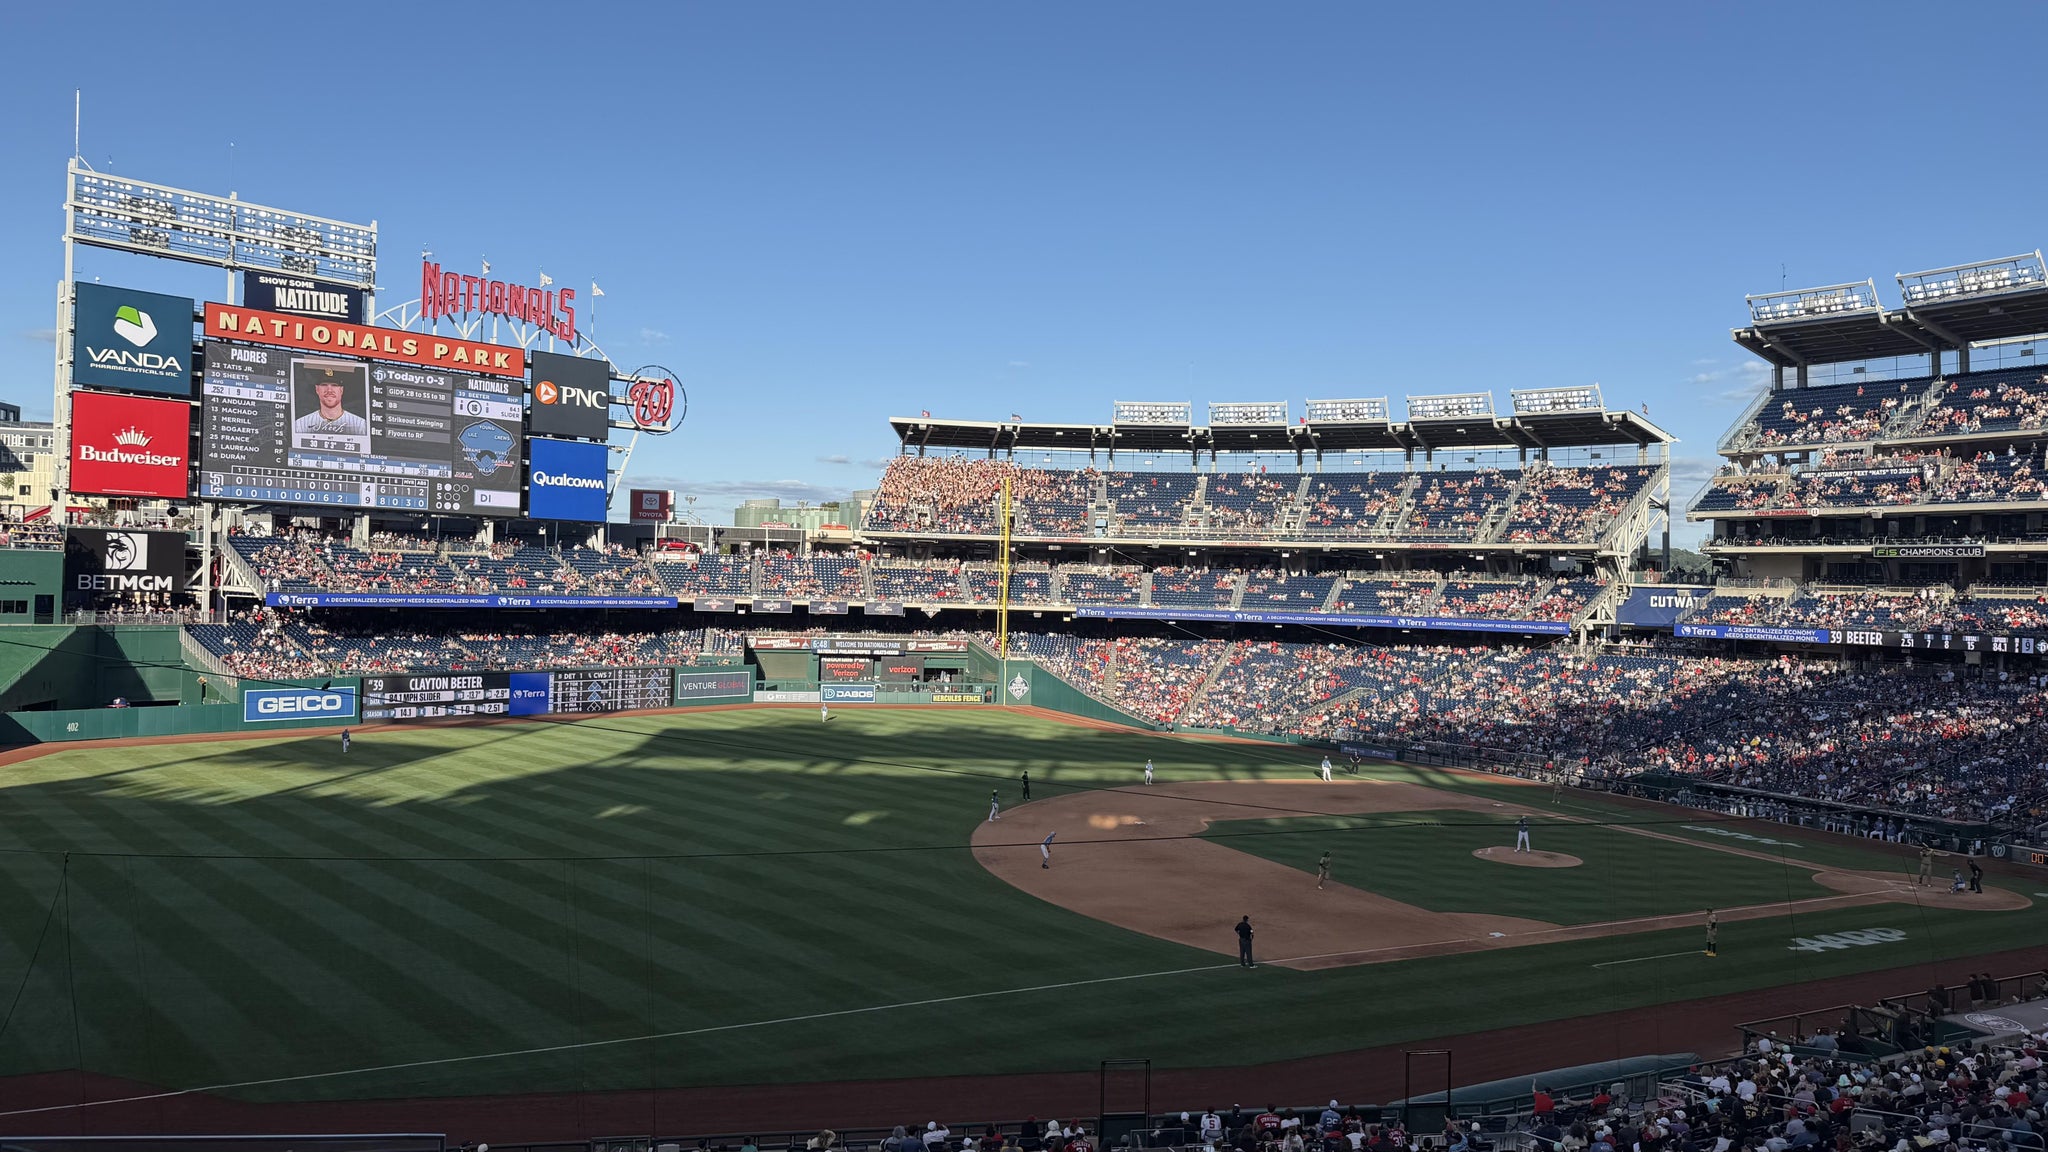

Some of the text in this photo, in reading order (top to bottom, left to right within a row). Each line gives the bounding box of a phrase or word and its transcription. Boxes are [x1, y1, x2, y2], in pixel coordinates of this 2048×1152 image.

[258, 276, 288, 286] SHOW
[276, 287, 348, 314] NATITUDE
[421, 260, 576, 342] NATIONALS
[220, 312, 510, 369] NATIONALS PARK
[86, 346, 182, 372] VANDA
[230, 348, 268, 364] PADRES
[90, 363, 164, 376] PHARMACEUTICALS
[387, 371, 445, 385] Today: 0-3
[468, 379, 509, 394] NATIONALS
[222, 398, 256, 407] ANDUJAR
[560, 386, 606, 410] PNC
[222, 407, 258, 416] MACHADO
[222, 416, 252, 425] MERRILL
[388, 416, 443, 428] Strikeout Swinging
[221, 426, 259, 434] BOGAERTS
[221, 434, 250, 443] FRANCE
[220, 444, 260, 452] LAUREANO
[80, 445, 181, 466] Budweiser
[533, 470, 604, 489] Qualcomm
[236, 488, 242, 496] 0
[419, 487, 424, 496] 2
[78, 574, 172, 591] BETMGM
[290, 595, 318, 604] Terra
[508, 597, 530, 606] Terra
[1692, 627, 1717, 636] Terra
[1830, 631, 1842, 644] 39
[1847, 631, 1883, 645] BEETER
[1901, 639, 1914, 647] 2.51
[1927, 640, 1931, 648] 7
[1967, 642, 1974, 650] 15
[1993, 643, 2007, 652] 84.1
[2025, 642, 2030, 651] 9
[409, 678, 448, 690] CLAYTON
[451, 676, 483, 689] BEETER
[683, 682, 717, 690] VENTURE
[419, 693, 440, 701] SLIDER
[258, 694, 342, 714] GEICO
[66, 722, 79, 732] 402
